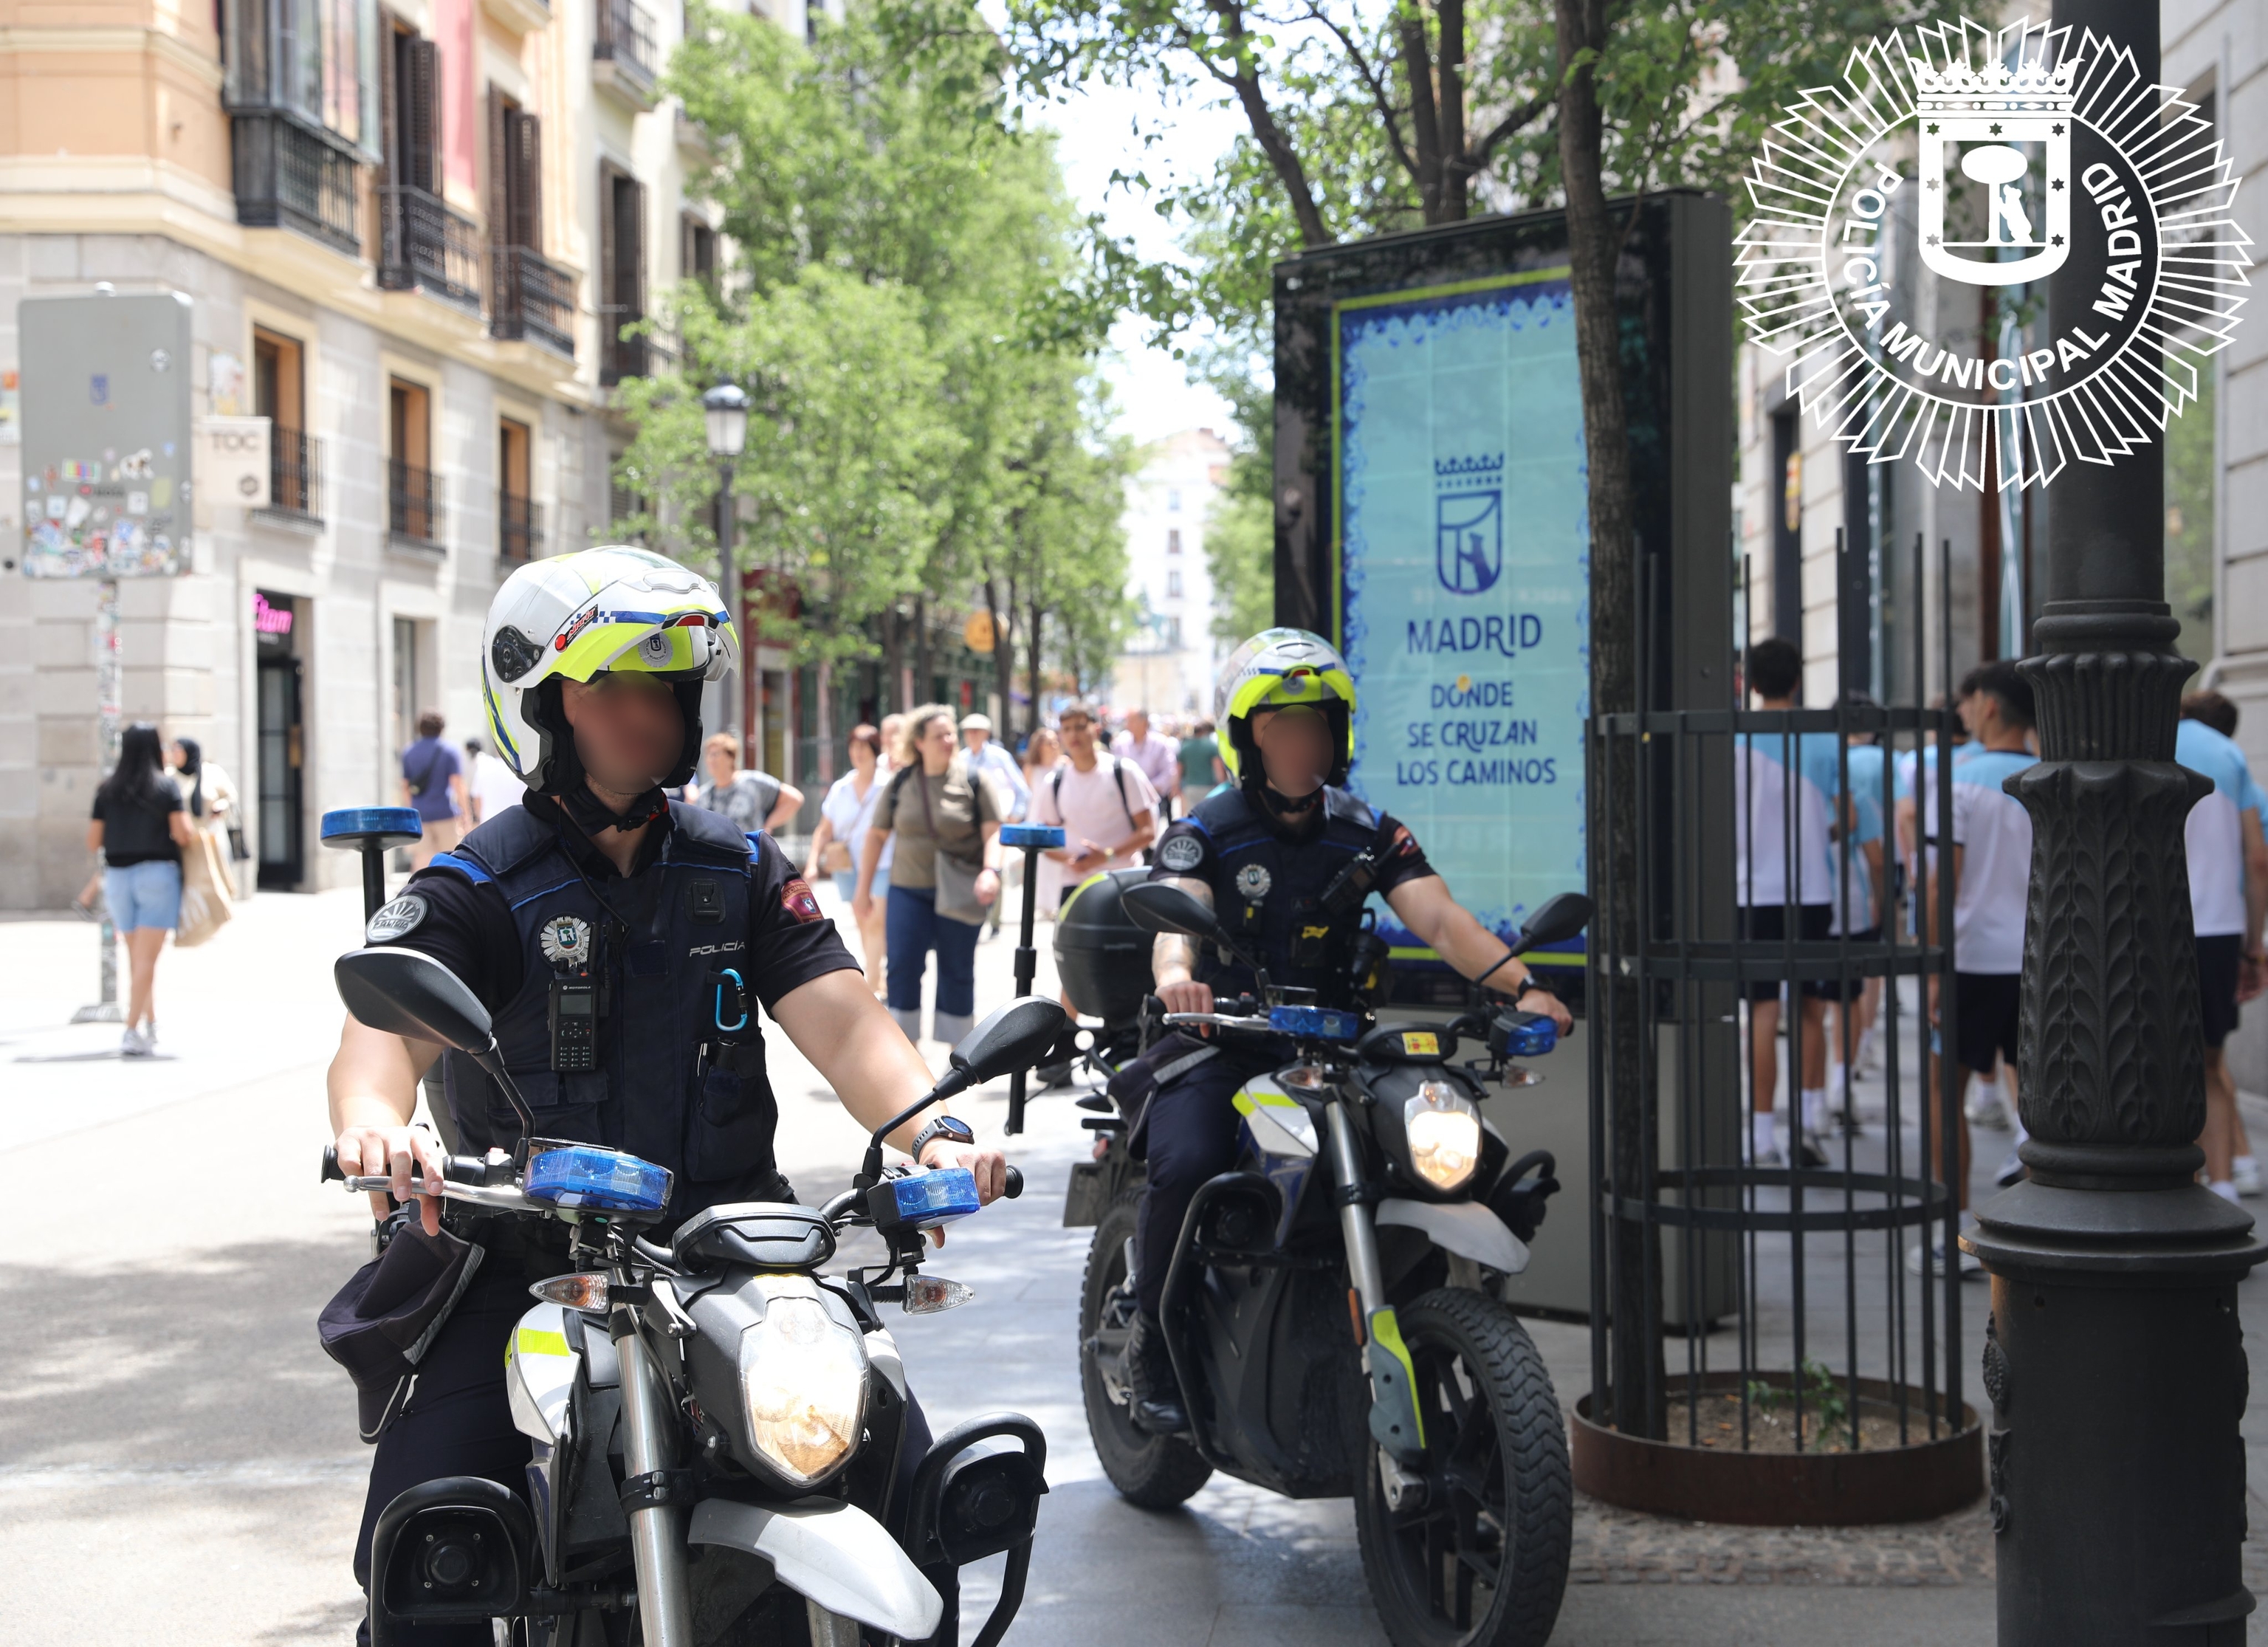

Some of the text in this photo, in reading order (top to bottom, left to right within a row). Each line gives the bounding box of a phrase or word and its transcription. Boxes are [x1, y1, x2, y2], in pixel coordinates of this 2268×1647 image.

[1406, 613, 1542, 657] MADRID
[1431, 681, 1513, 709] DONDE
[1407, 719, 1537, 752] SE CRUZAN
[1397, 758, 1556, 786] LOS CAMINOS
[689, 940, 746, 957] POLICÍA
